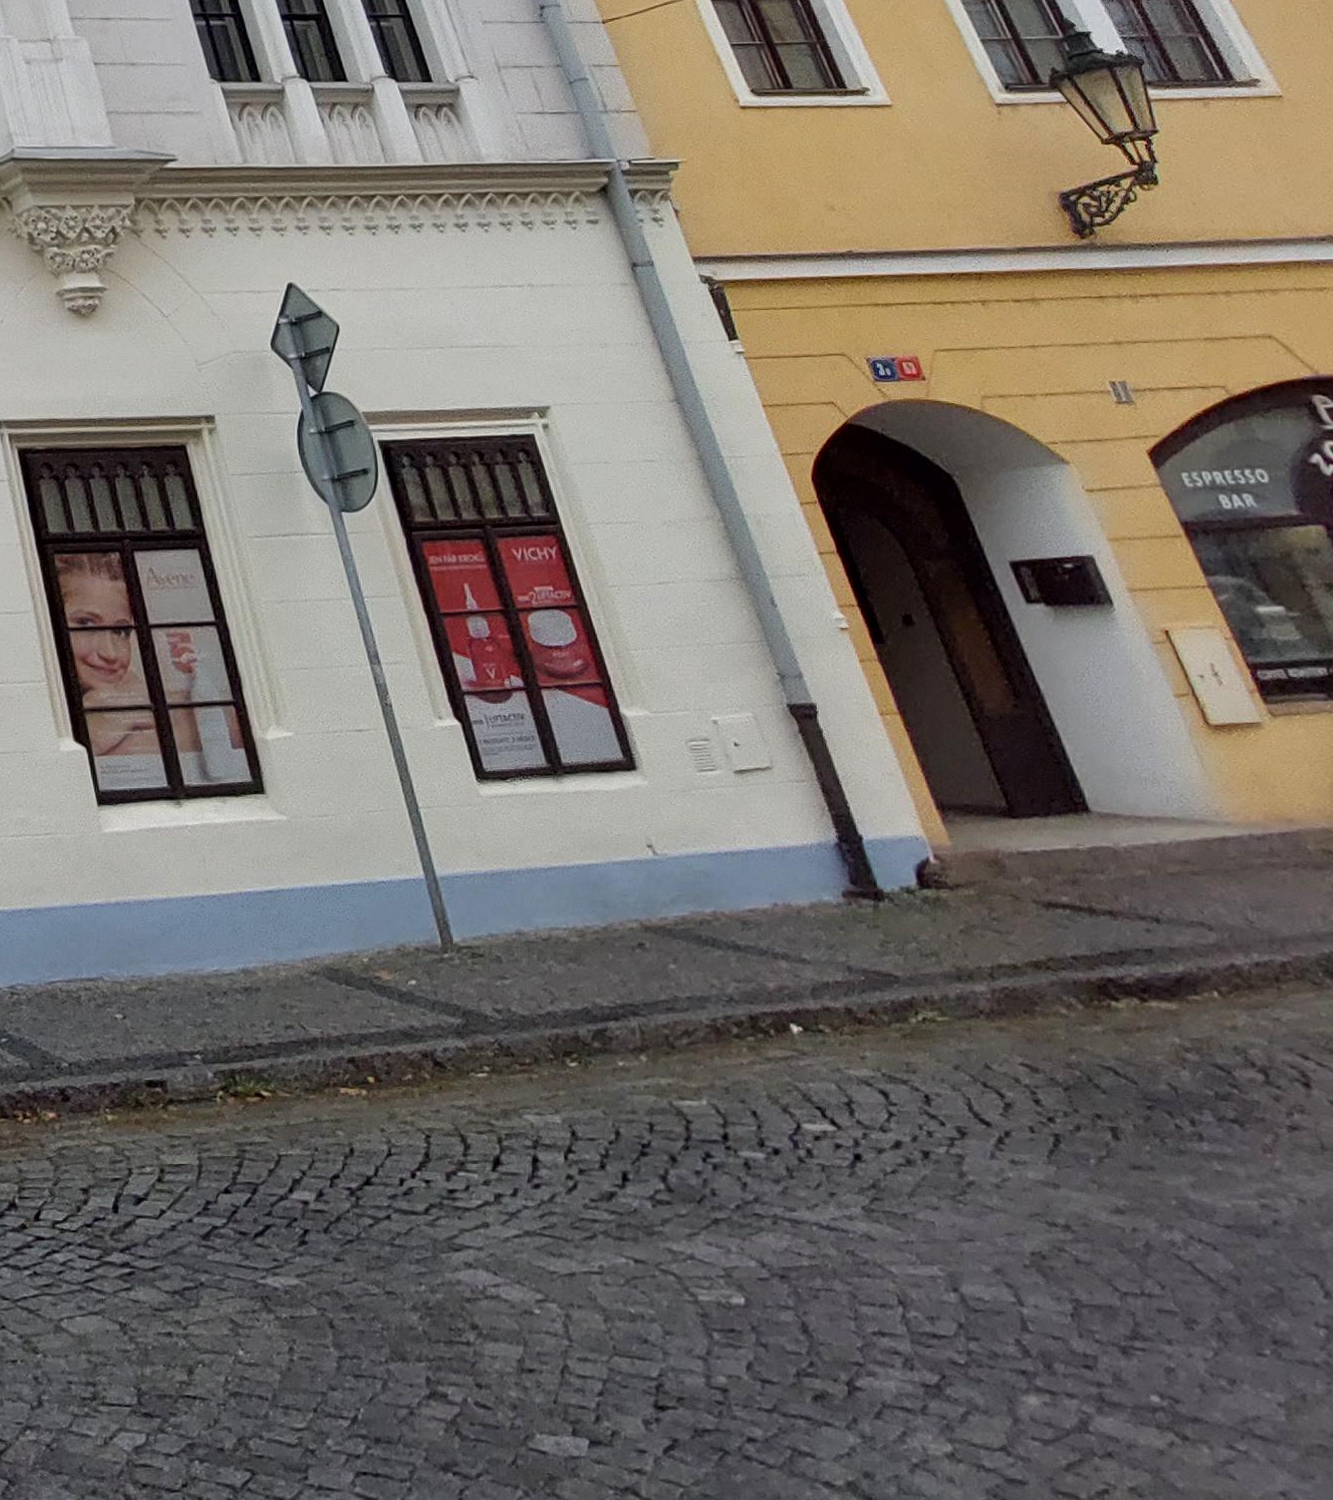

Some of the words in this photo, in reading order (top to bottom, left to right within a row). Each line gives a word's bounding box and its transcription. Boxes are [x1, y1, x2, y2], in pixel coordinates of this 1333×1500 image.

[1180, 468, 1270, 488] ESPRESSO
[1218, 493, 1258, 510] BAR
[511, 546, 558, 561] VICHY
